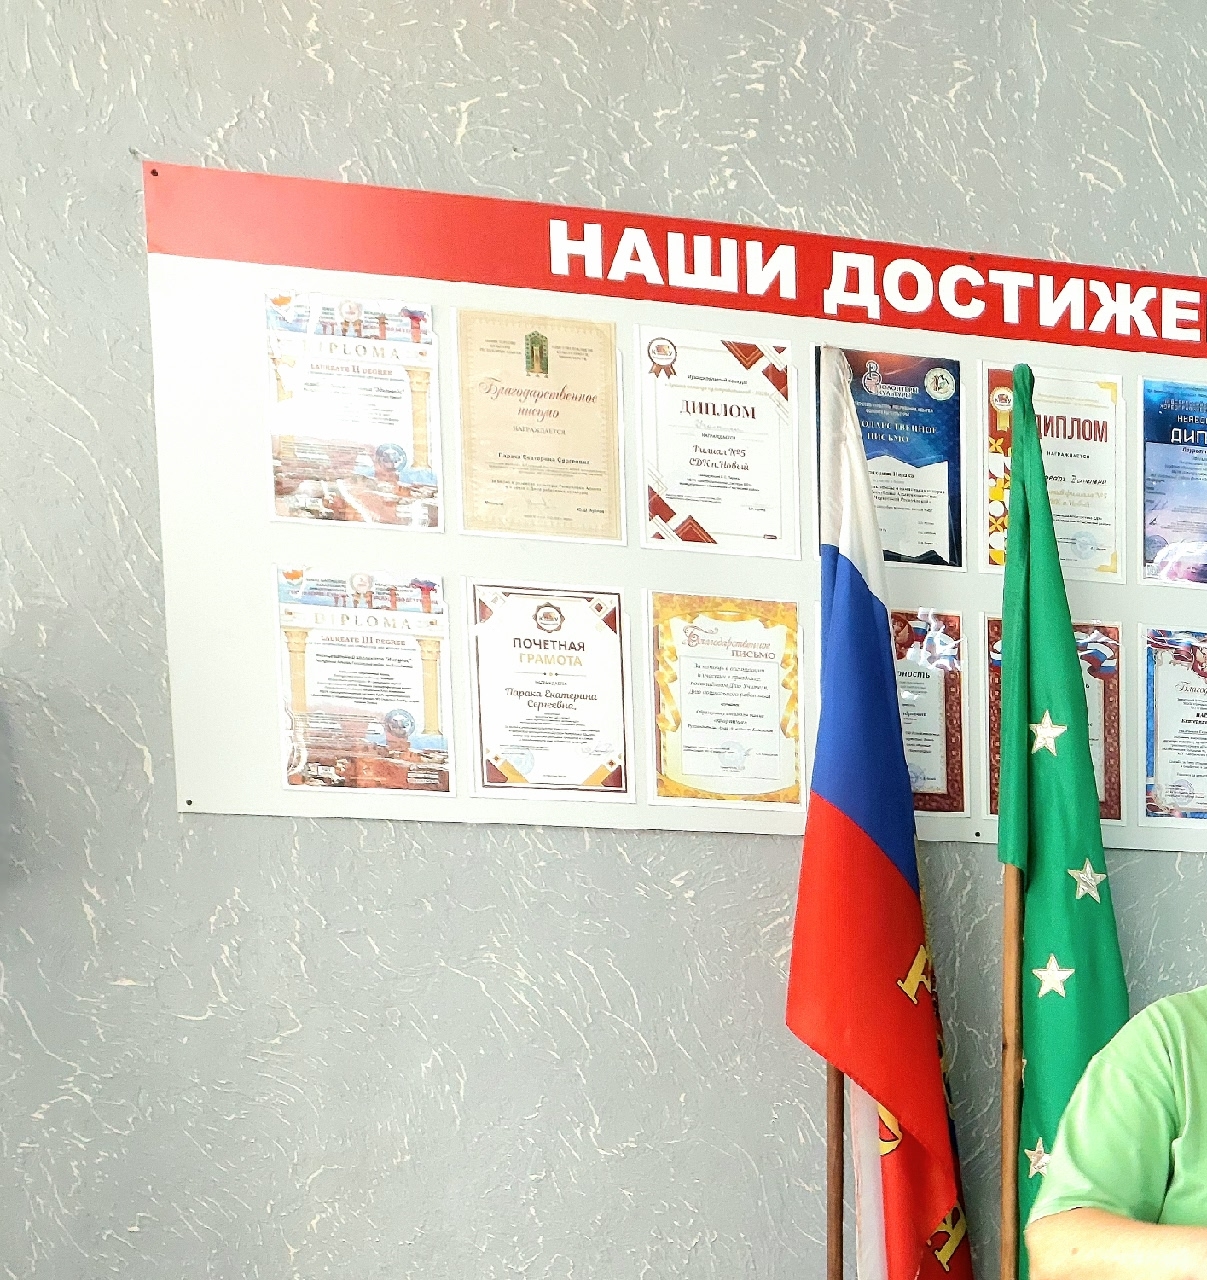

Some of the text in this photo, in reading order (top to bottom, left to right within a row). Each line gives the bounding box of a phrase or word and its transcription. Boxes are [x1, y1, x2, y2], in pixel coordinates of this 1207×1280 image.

[549, 218, 799, 301] НАШИ
[680, 399, 757, 420] ДИПЛОМ
[314, 612, 412, 630] DIPLOMA
[513, 637, 586, 652] ПОЧЕТНАЯ
[519, 653, 583, 667] ГРАМОТА
[731, 649, 776, 660] ПИСЬМО
